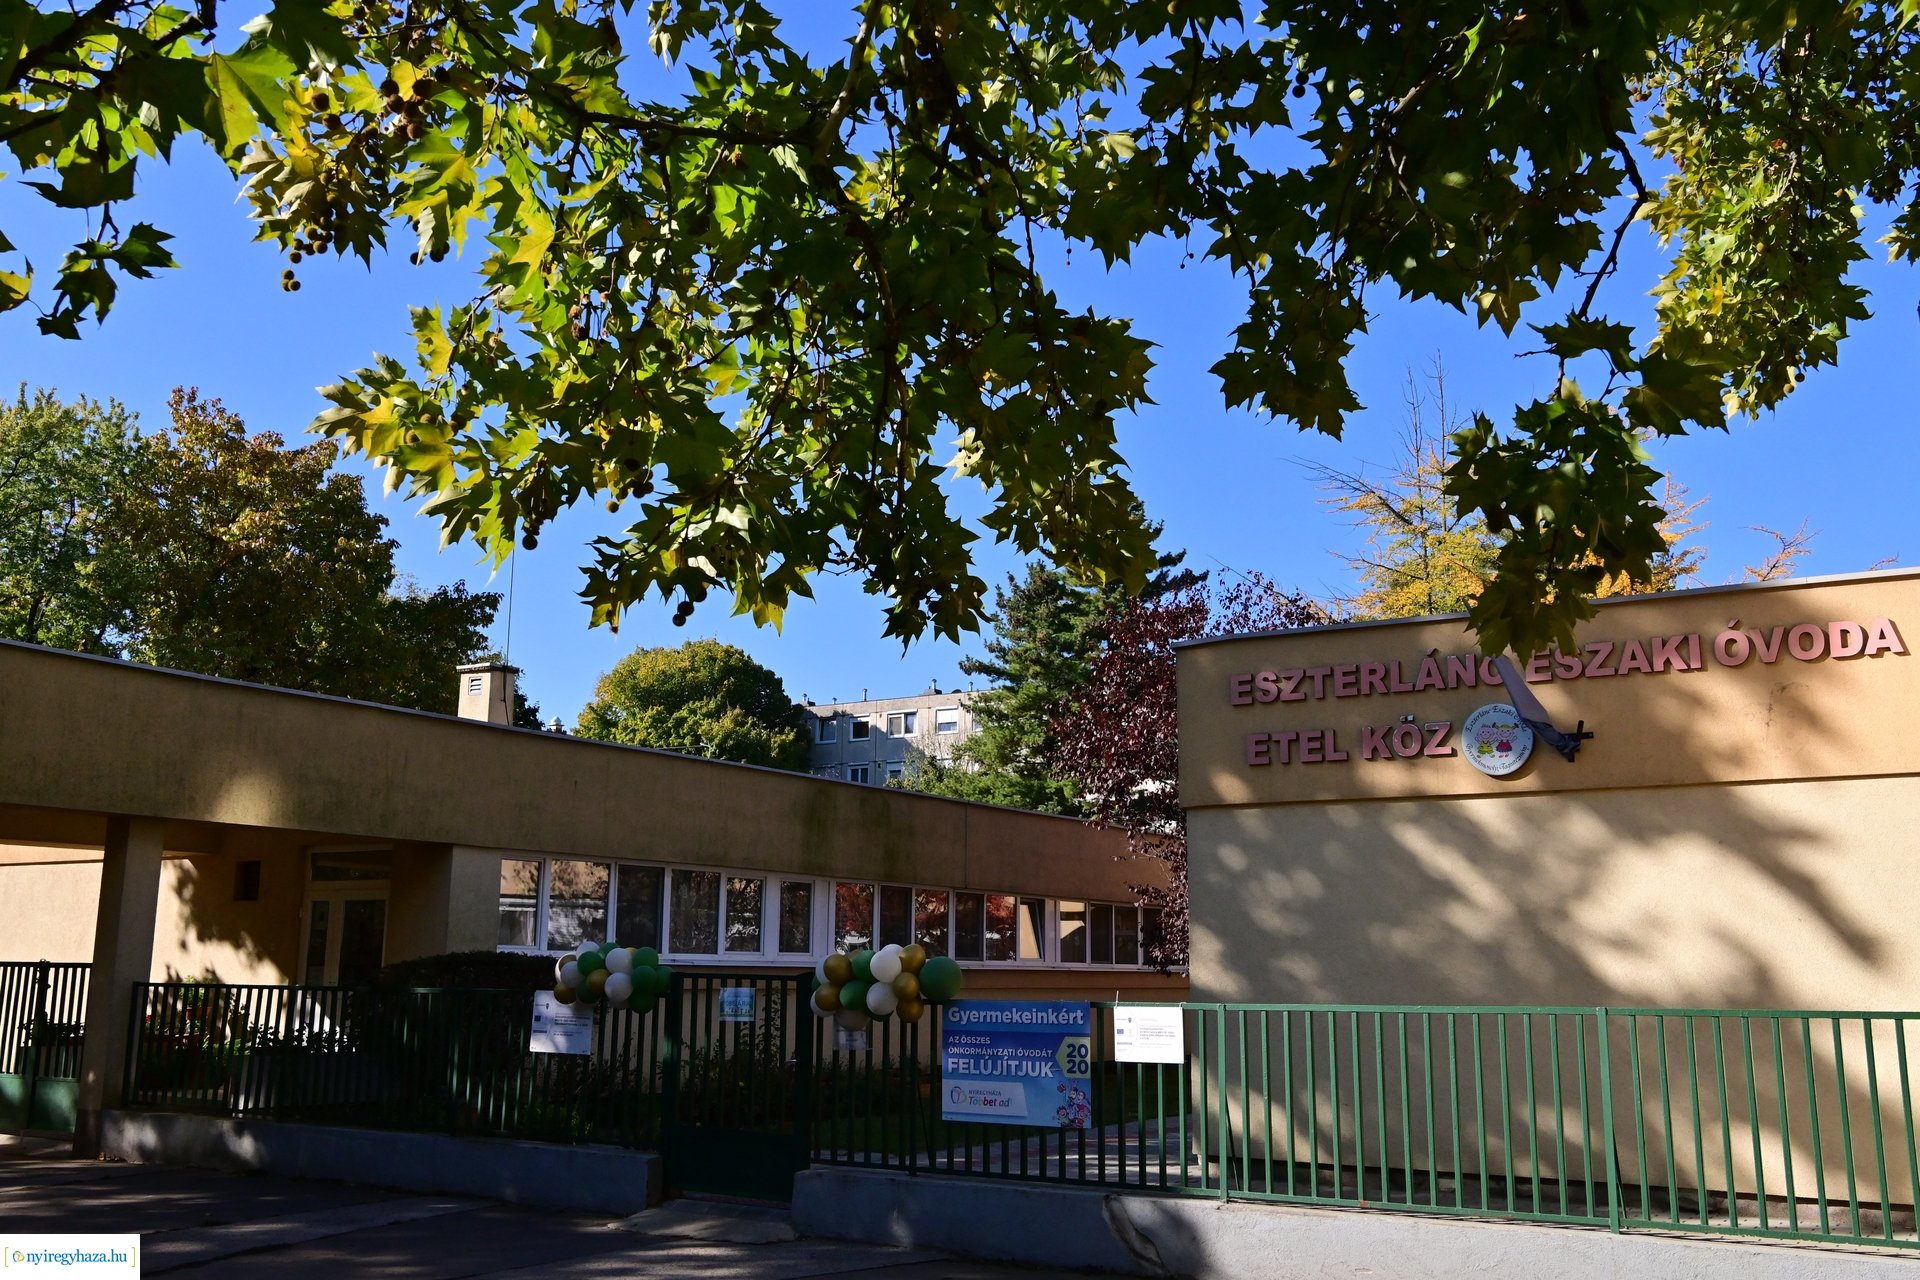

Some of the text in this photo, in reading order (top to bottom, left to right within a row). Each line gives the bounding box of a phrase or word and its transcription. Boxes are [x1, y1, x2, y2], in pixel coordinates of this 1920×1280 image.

[1714, 617, 1905, 666] ÓVODA
[1248, 713, 1453, 765] ETEL KÖZ
[948, 1007, 1084, 1025] Gyermekeinkért
[948, 1034, 991, 1044] AZ ÖSSZES
[948, 1046, 1053, 1057] ÖNKORMÁNYZATI ÓVODÁT
[948, 1055, 1054, 1078] FELÚJÍTJUK
